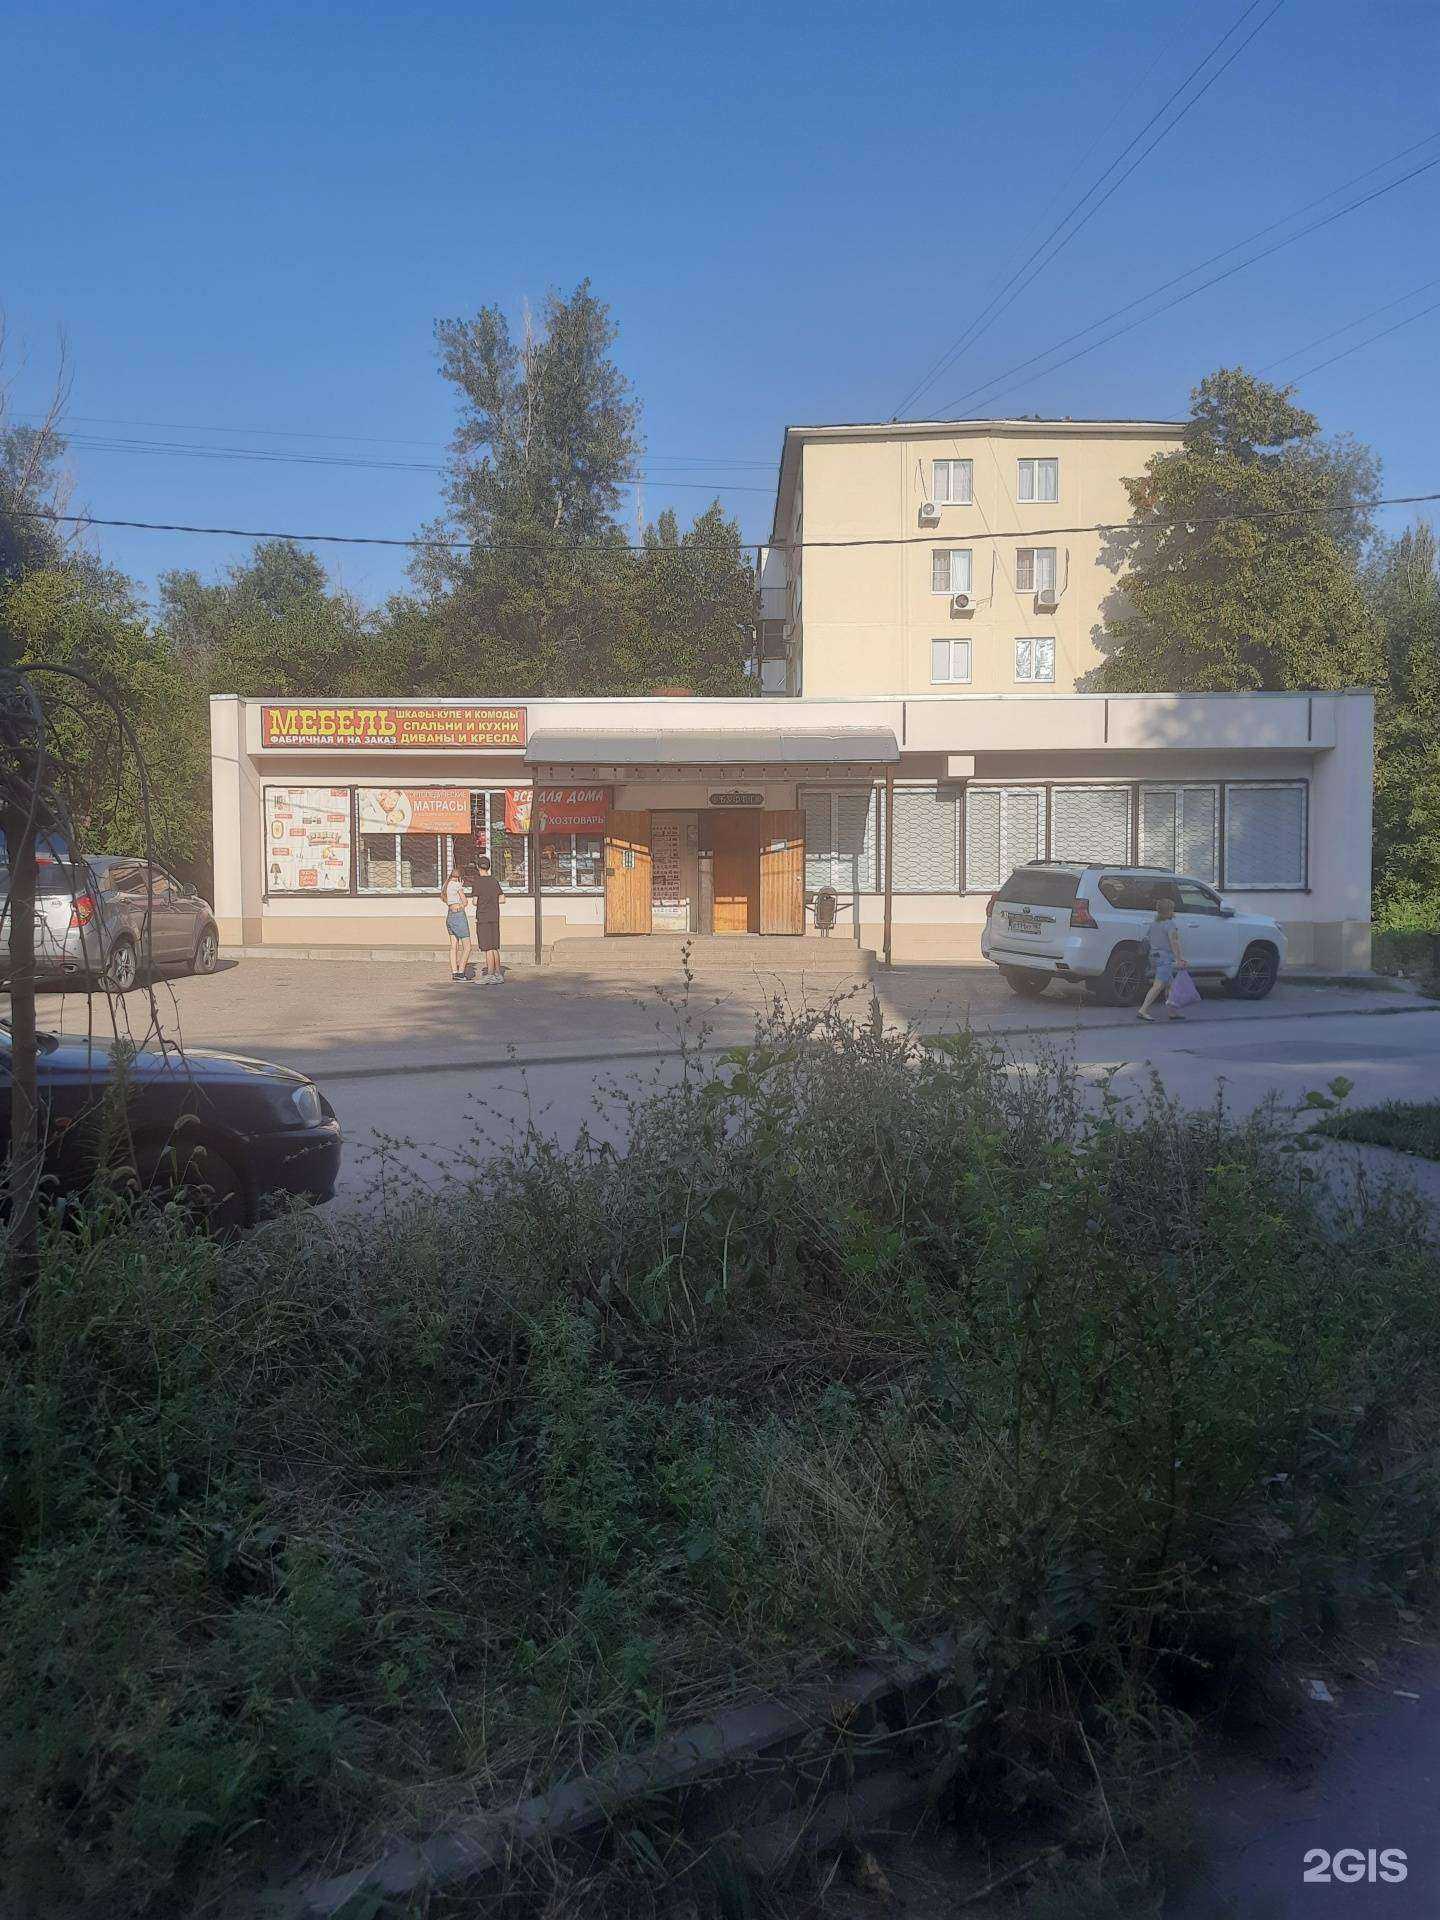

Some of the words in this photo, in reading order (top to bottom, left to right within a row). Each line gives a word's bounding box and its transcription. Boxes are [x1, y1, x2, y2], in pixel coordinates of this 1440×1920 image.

[396, 710, 461, 719] ШКАФЫ-КУПЕ
[464, 710, 472, 719] И
[475, 710, 518, 720] КОМОДЫ
[269, 709, 397, 736] МЕБЕЛЬ
[403, 721, 463, 731] СПАЛЬНИ
[466, 722, 475, 731] И
[479, 722, 519, 731] КУХНИ
[270, 735, 334, 744] ФАБРИЧНАЯ
[336, 735, 344, 744] И
[347, 735, 362, 744] НА
[364, 736, 397, 745] ЗАКАЗ
[401, 733, 454, 743] ДИВАНЫ
[459, 733, 467, 743] И
[471, 733, 519, 743] КРЕСЛА
[513, 790, 533, 802] ВСЕ
[538, 790, 563, 803] ДЛЯ
[567, 790, 604, 804] ДОМА
[413, 800, 467, 812] МАТРАСЫ
